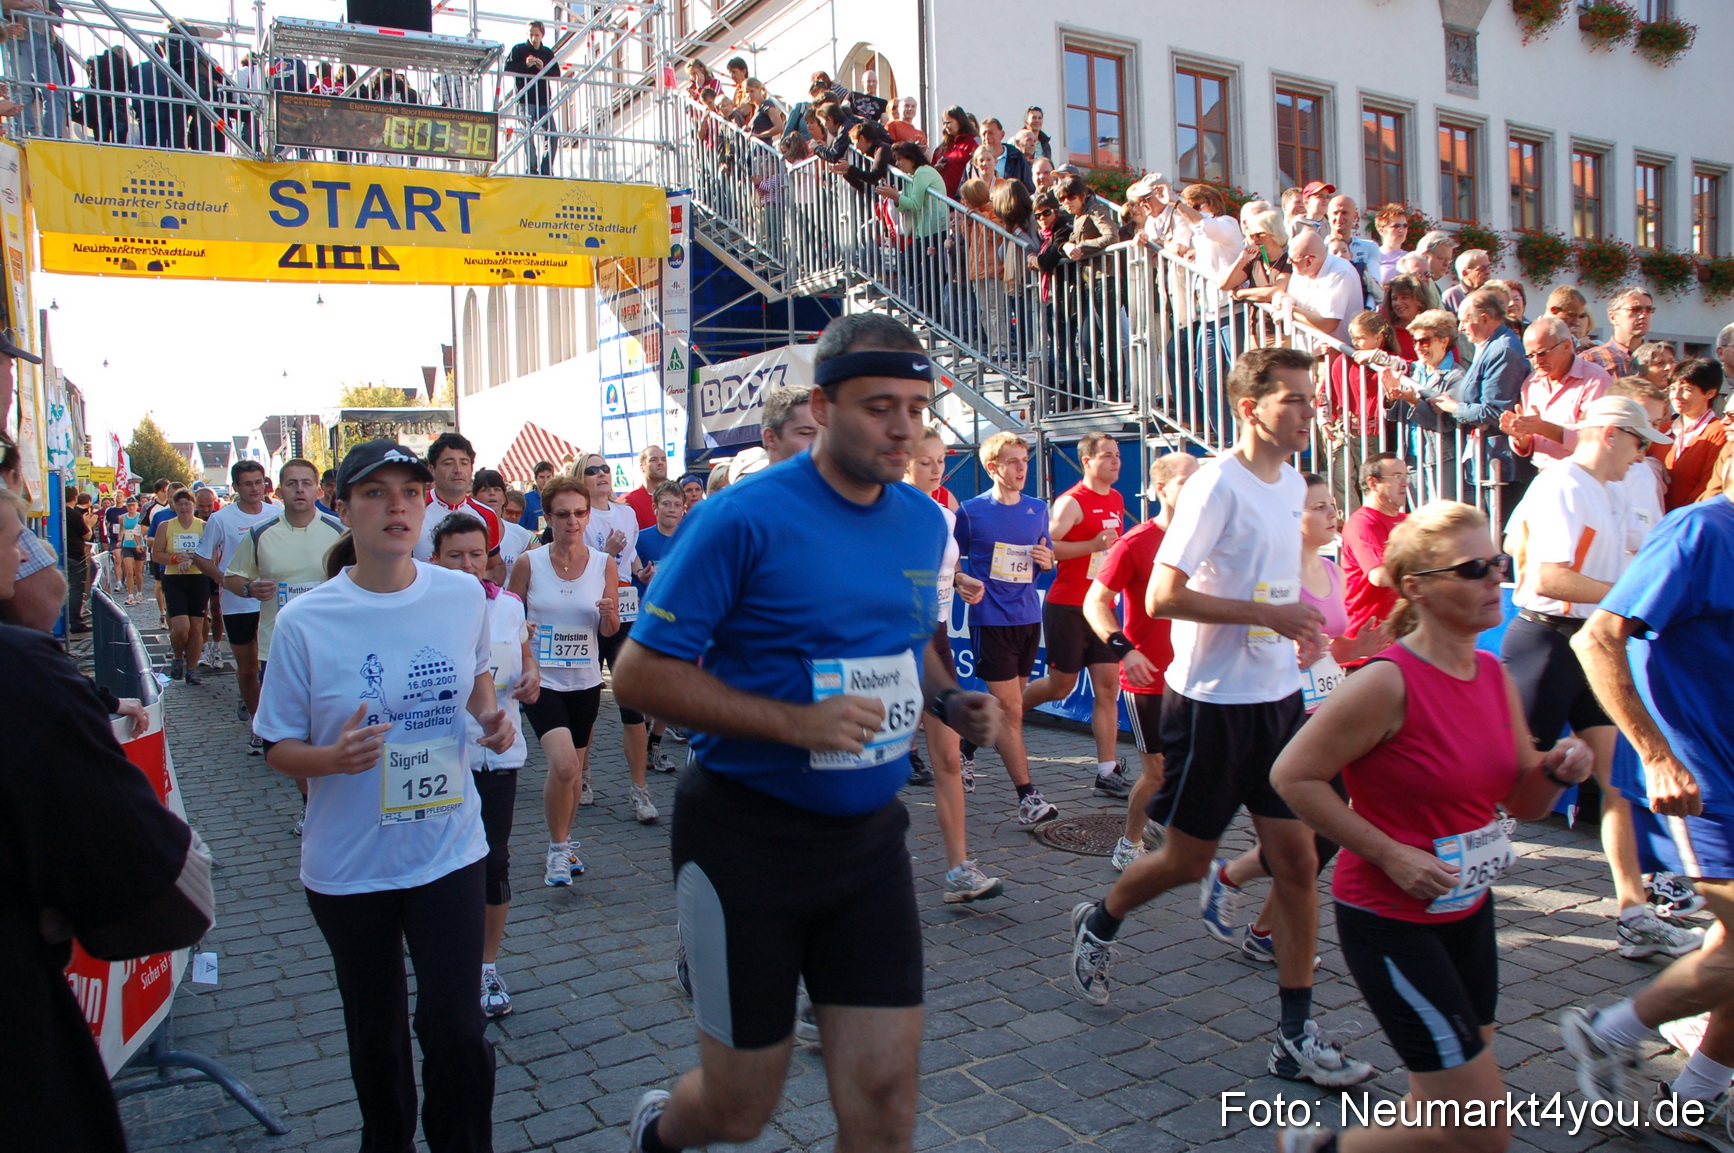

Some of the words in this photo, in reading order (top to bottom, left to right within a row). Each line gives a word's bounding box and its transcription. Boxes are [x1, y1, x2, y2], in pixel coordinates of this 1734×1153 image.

[350, 102, 398, 114] Elektronische
[401, 107, 489, 122] Sportstätteneinrichtungen
[74, 193, 160, 209] Neumarkter
[165, 198, 229, 213] Stadtlauf
[269, 180, 480, 234] START
[519, 218, 584, 231] Neumarkter
[588, 222, 637, 234] Stadtlauf
[1010, 562, 1028, 573] 164
[289, 586, 313, 594] Matthia
[618, 602, 636, 612] 214
[554, 633, 588, 641] Christine
[555, 644, 589, 656] 3775
[407, 675, 457, 690] 16.09.2007
[851, 669, 901, 690] Robert
[389, 705, 457, 722] Neumarkter
[404, 715, 455, 731] Stadtlau
[390, 748, 429, 770] Sigrid
[402, 774, 448, 801] 152
[140, 965, 161, 990] Sicher
[66, 972, 102, 1024] aun
